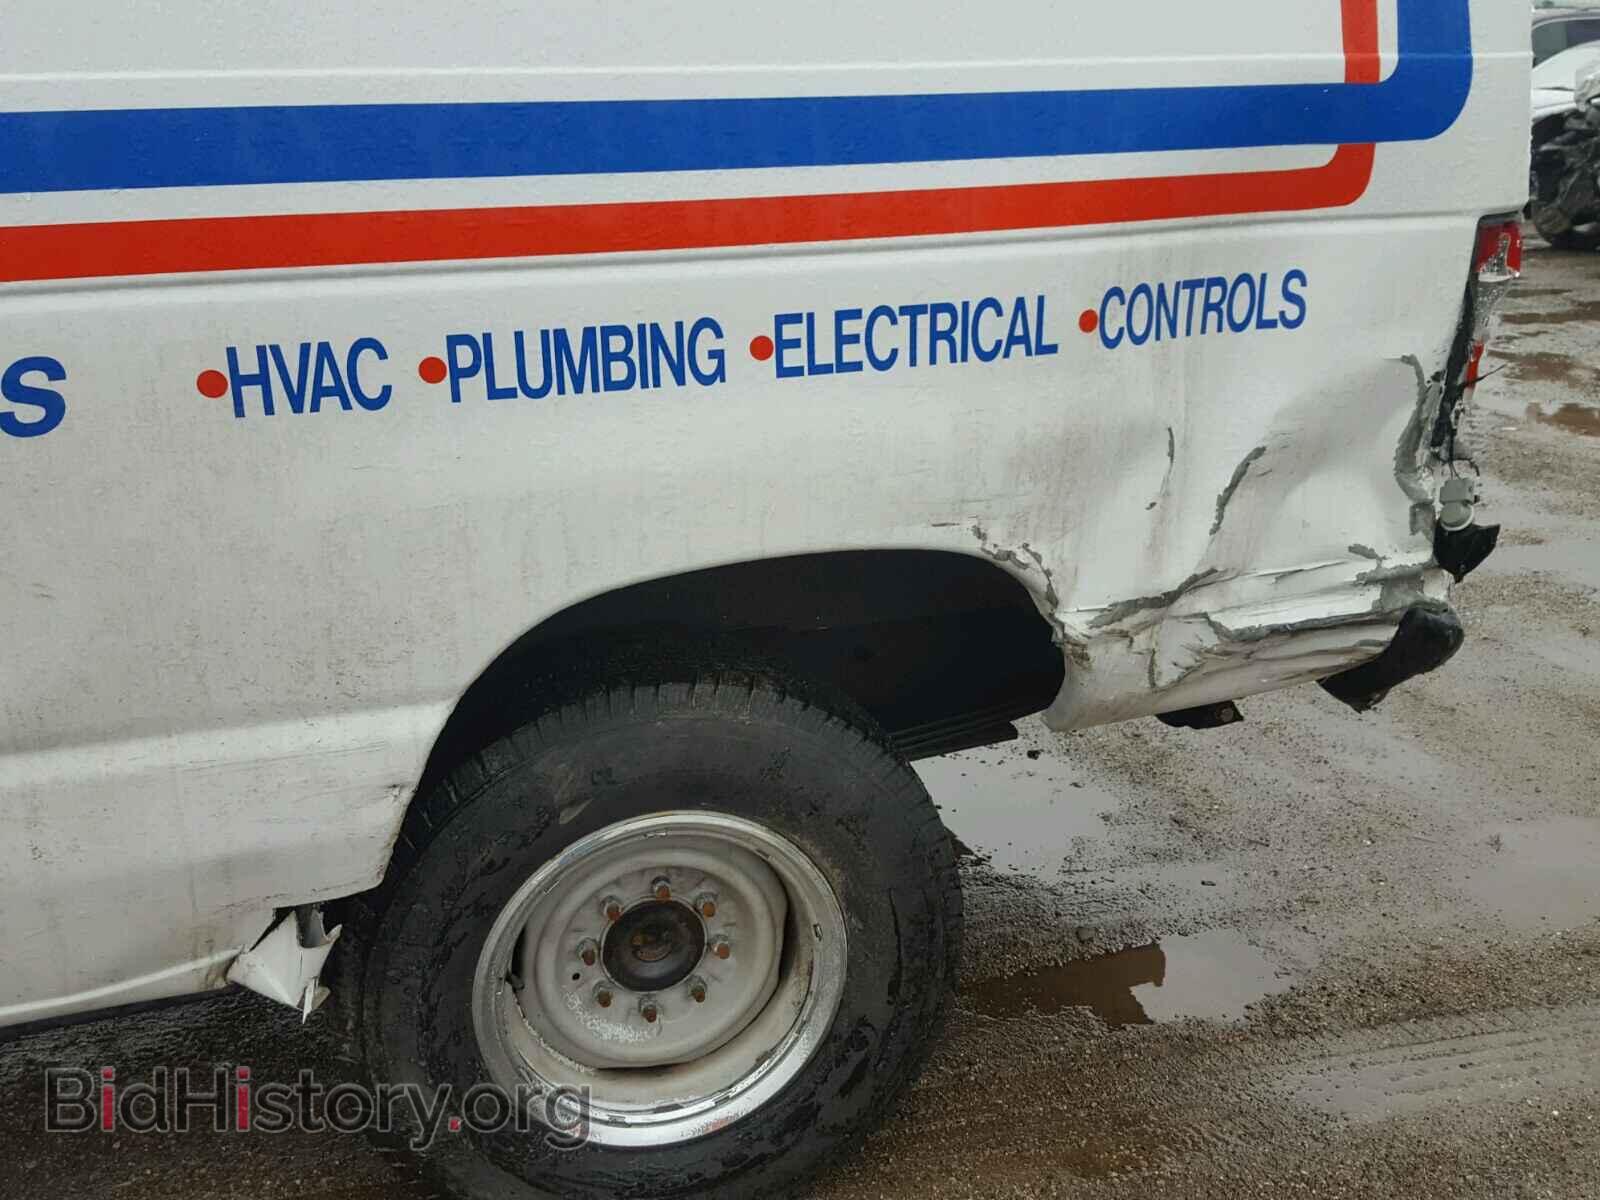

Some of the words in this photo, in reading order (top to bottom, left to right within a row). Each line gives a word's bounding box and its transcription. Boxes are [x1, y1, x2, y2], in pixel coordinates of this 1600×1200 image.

[226, 337, 393, 418] HVAC
[446, 316, 727, 404] PLUMBING
[775, 294, 1059, 380] ELECTRICAL
[1100, 268, 1308, 349] CONTROLS
